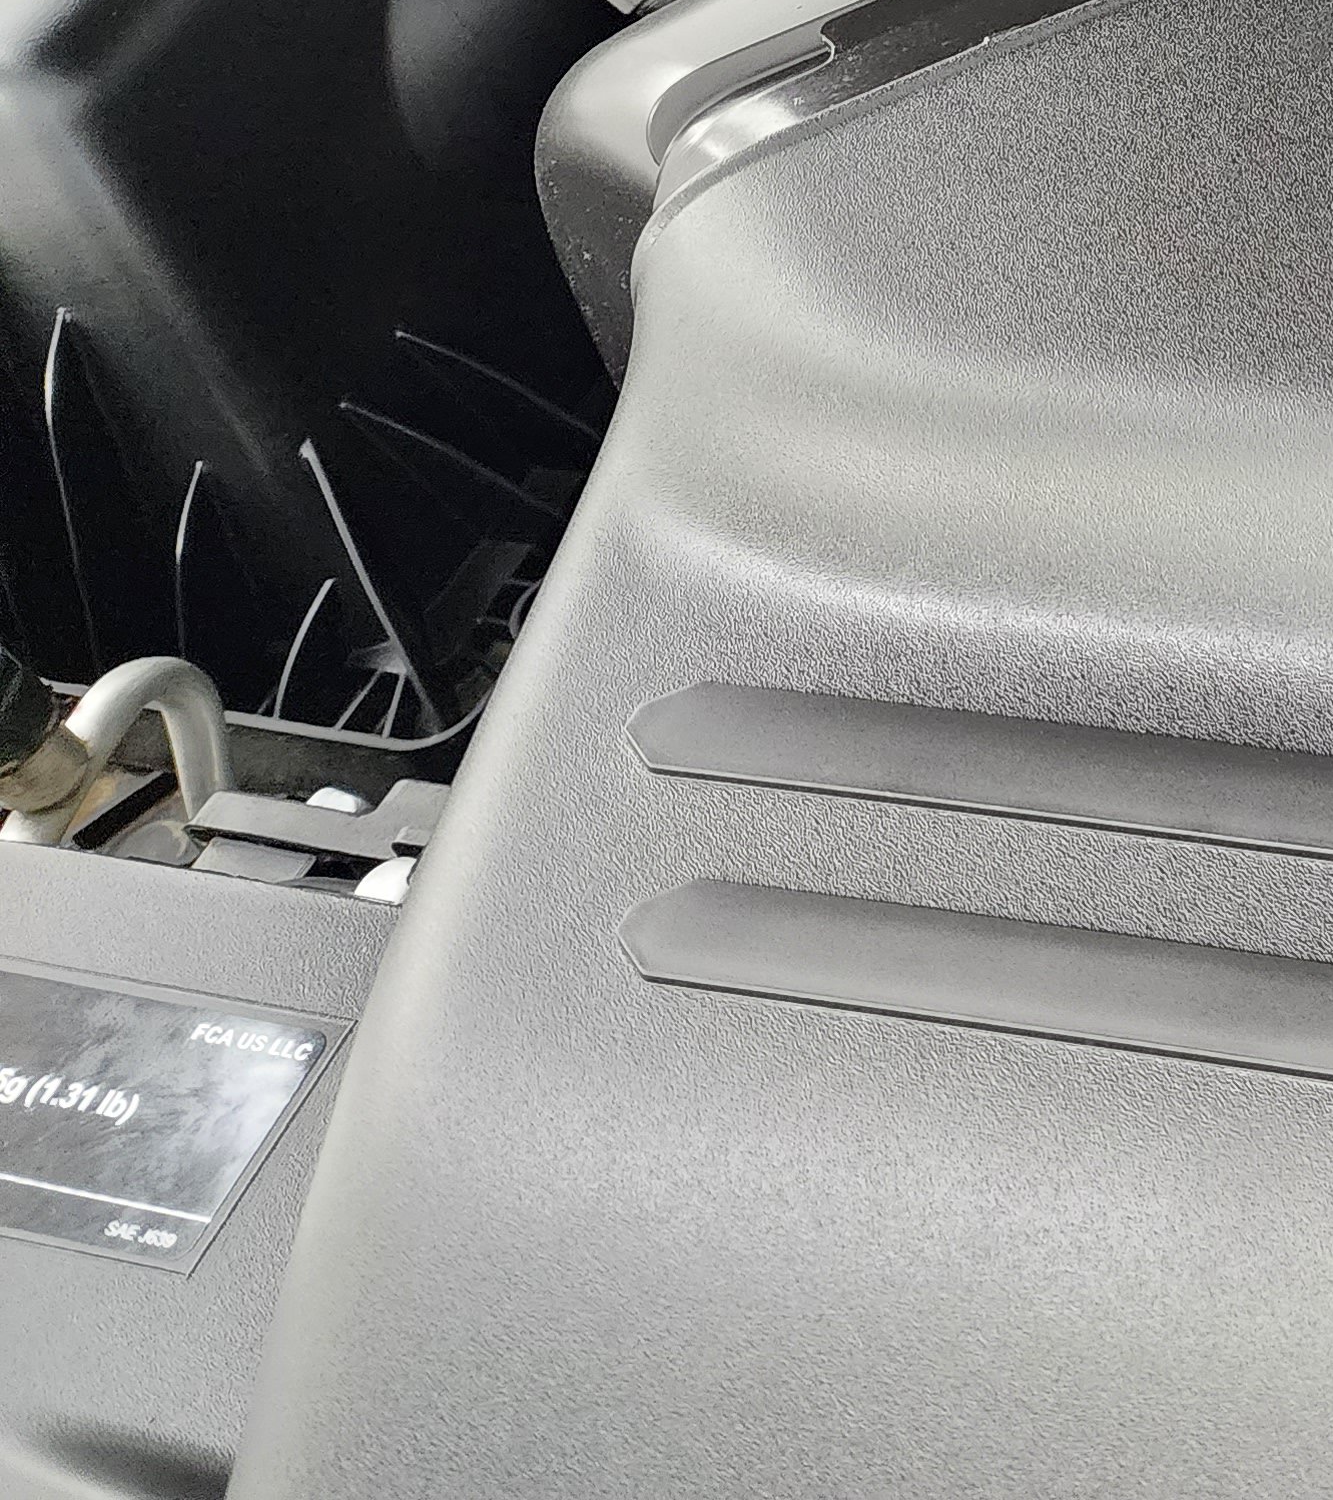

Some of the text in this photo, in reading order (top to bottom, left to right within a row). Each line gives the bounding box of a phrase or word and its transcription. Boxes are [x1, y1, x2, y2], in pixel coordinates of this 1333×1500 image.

[190, 1023, 314, 1061] FCA US LLC
[23, 1072, 99, 1112] (1.31
[96, 1088, 141, 1126] lb)
[103, 1220, 141, 1242] SAE
